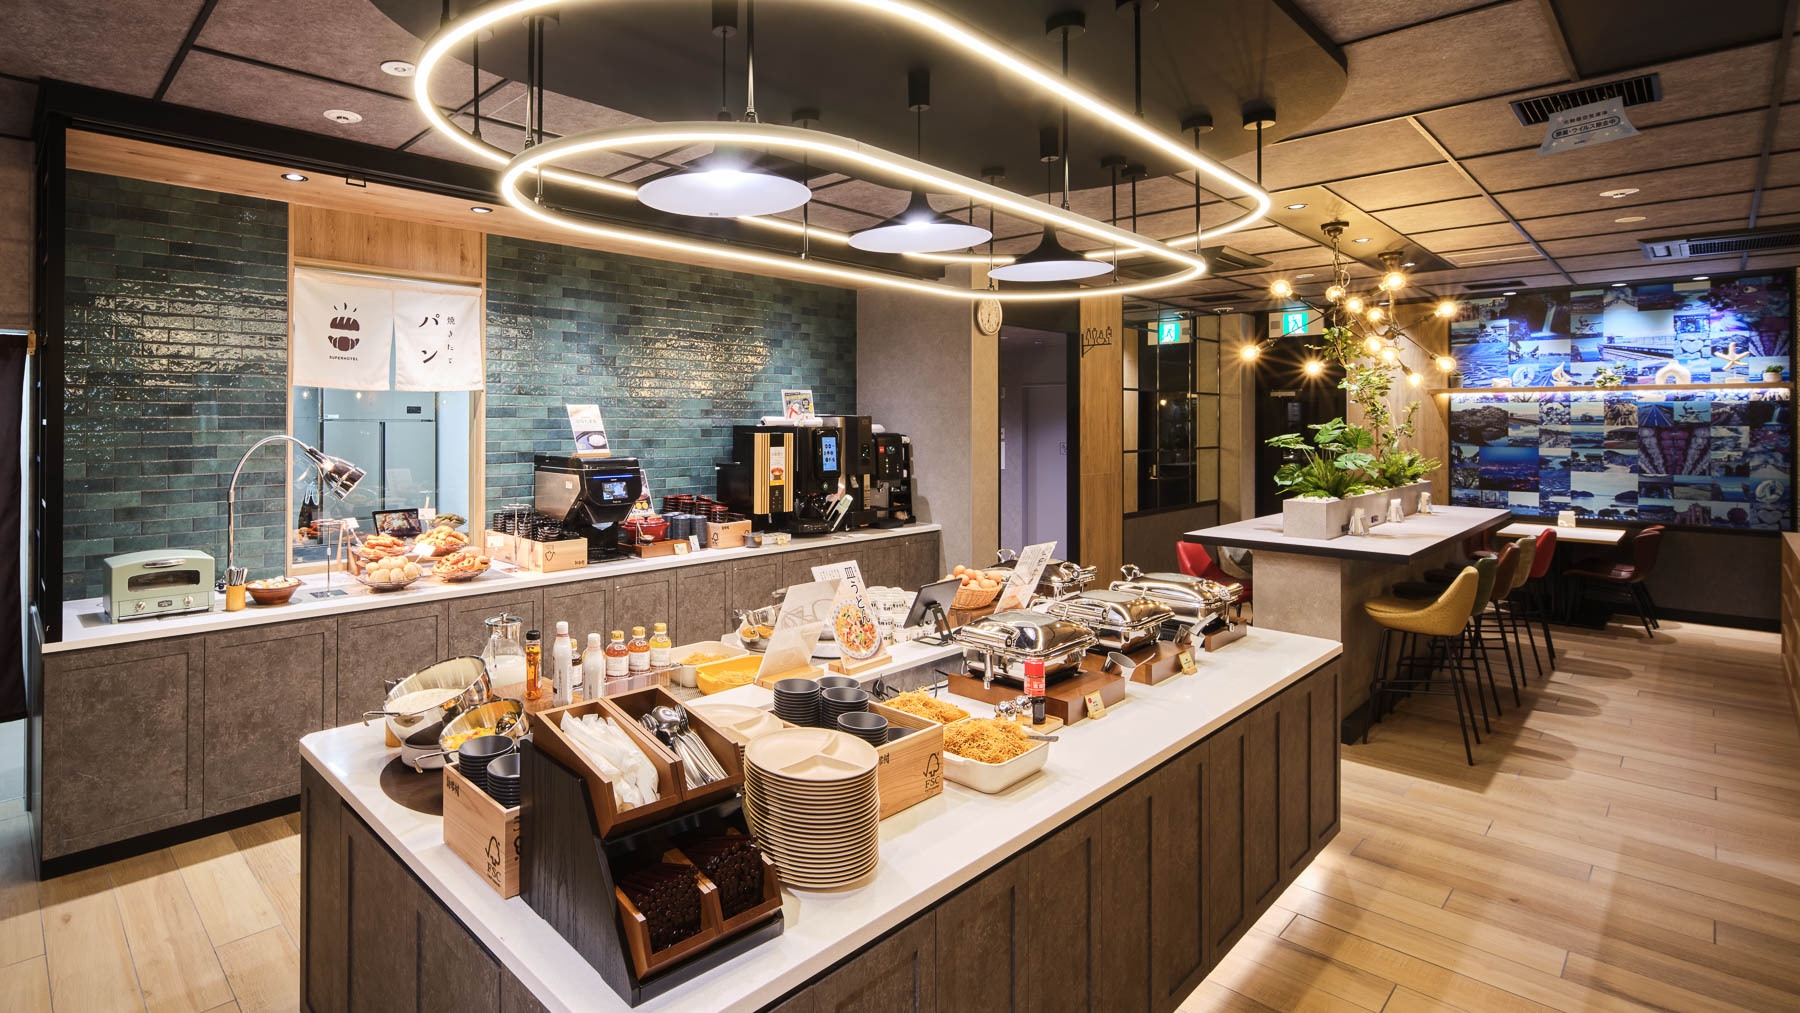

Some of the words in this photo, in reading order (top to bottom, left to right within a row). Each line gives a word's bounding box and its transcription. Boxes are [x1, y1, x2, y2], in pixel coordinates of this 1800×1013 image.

[418, 313, 440, 364] パン
[844, 566, 871, 624] 皿うどん
[925, 775, 940, 789] FSC
